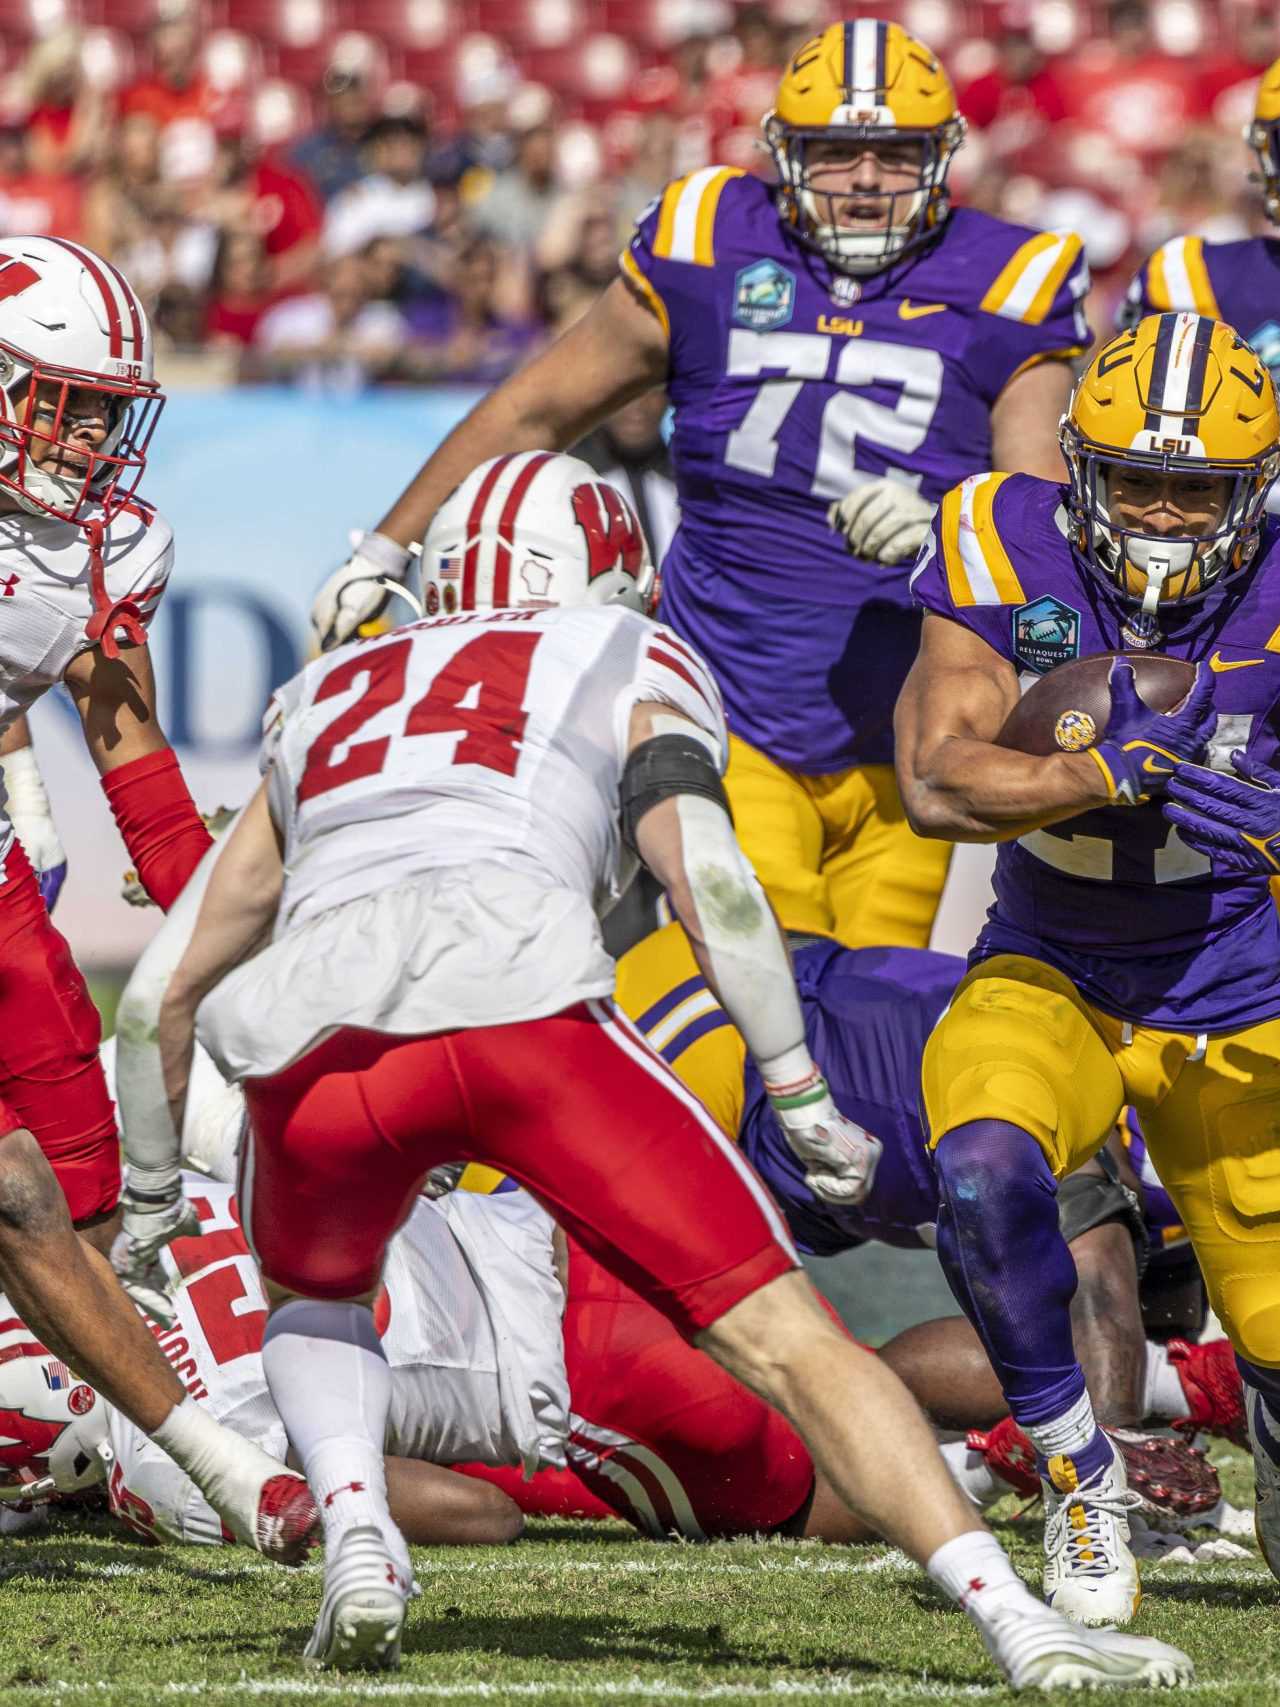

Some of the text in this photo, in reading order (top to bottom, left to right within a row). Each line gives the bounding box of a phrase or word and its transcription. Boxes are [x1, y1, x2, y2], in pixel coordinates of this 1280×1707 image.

[816, 314, 864, 337] LSU
[724, 329, 944, 501] 72
[1150, 436, 1191, 456] LSU
[1019, 646, 1068, 659] RELIAQUEST
[1035, 656, 1054, 665] BOWL
[295, 630, 545, 808] 24
